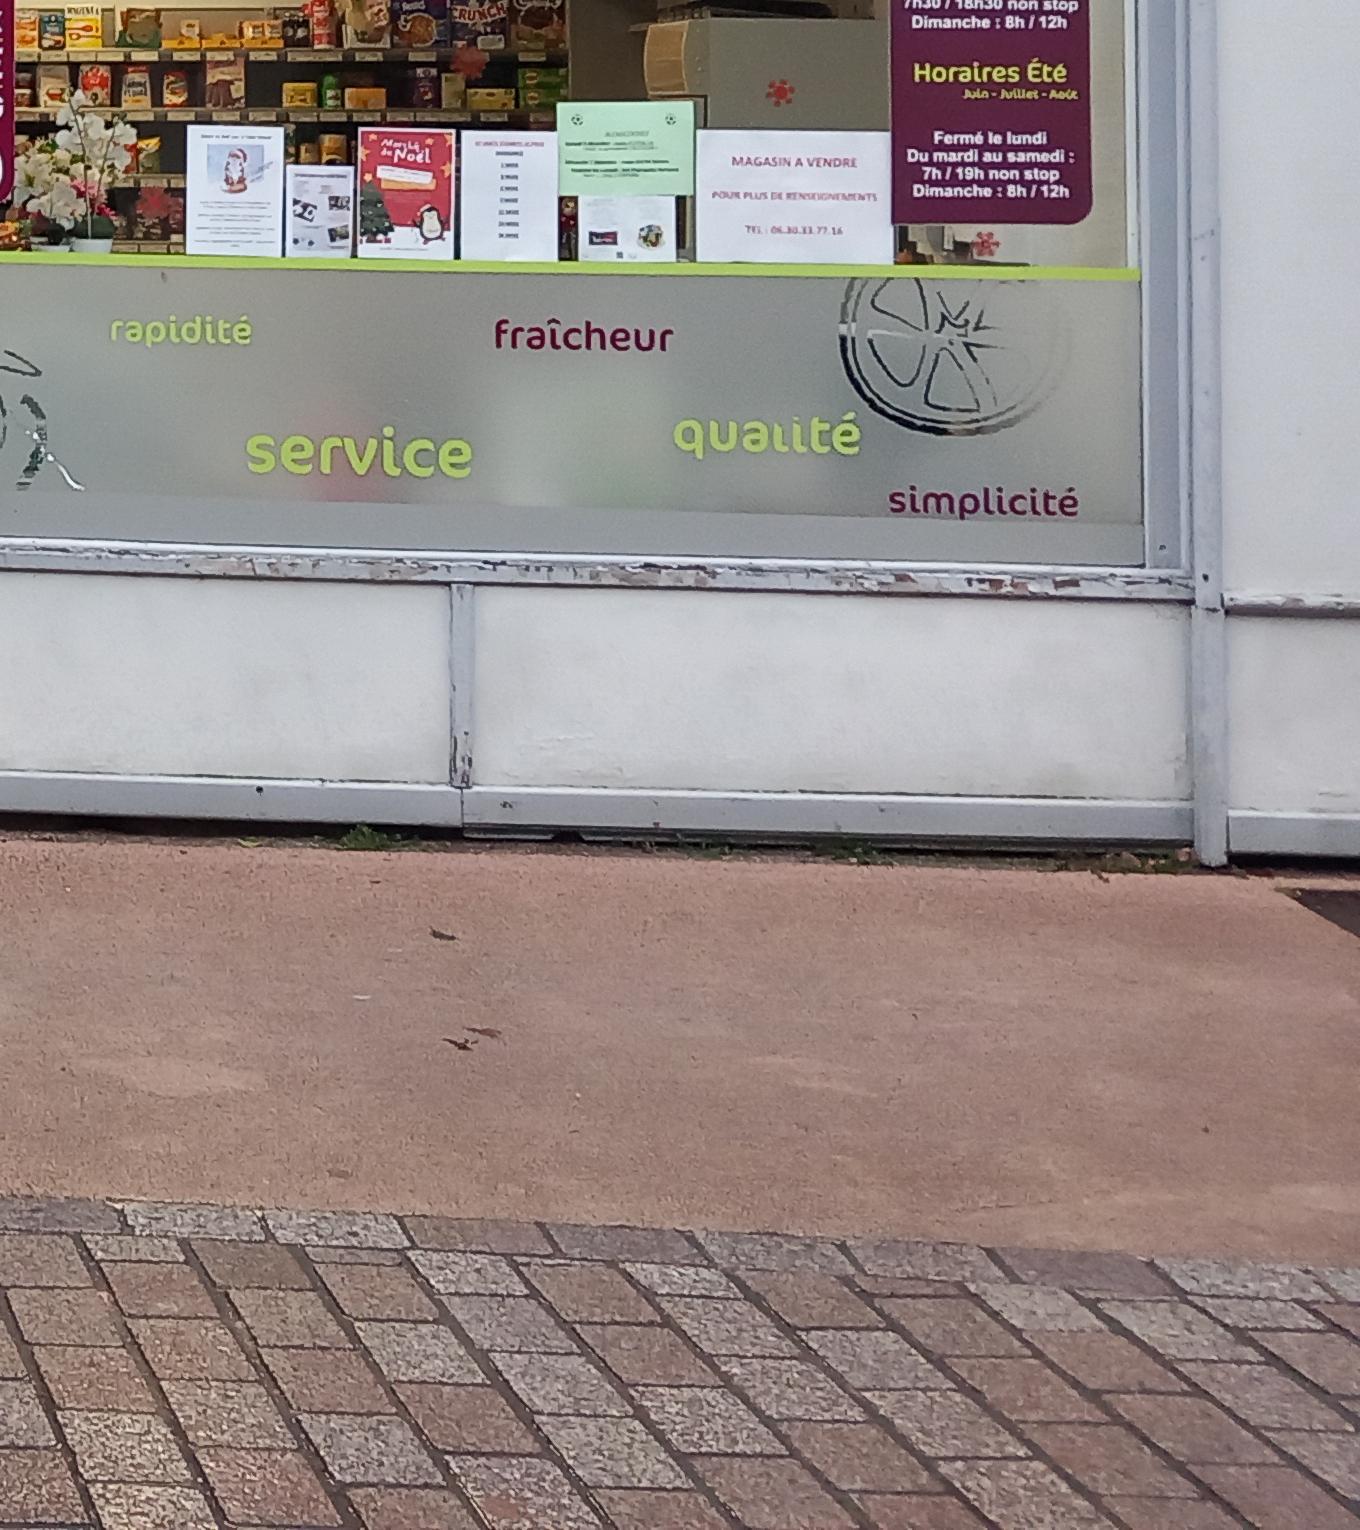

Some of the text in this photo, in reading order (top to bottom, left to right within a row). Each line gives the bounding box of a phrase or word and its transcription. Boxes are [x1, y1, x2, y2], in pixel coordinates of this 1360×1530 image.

[451, 1, 507, 21] CRUNCH
[1007, 0, 1038, 10] non
[912, 15, 991, 29] Dimanche
[1005, 15, 1025, 29] 8h
[1028, 16, 1035, 29] /
[1039, 16, 1068, 29] 12h
[913, 57, 1068, 83] Horaires Été
[962, 88, 989, 100] Juin
[999, 88, 1039, 100] Juillet
[933, 131, 1047, 145] Fermé le lundi
[394, 148, 431, 163] Noël
[732, 156, 857, 168] MAGASIN A VENDRE
[906, 149, 929, 163] Du
[933, 149, 979, 163] mardi
[982, 152, 1002, 163] au
[1007, 149, 1065, 163] samedi
[922, 166, 1060, 183] 7h / 19h non stop
[711, 191, 740, 200] POUR
[743, 191, 768, 200] PLUS
[912, 184, 992, 198] Dimanche
[1007, 184, 1026, 198] 8h
[1030, 185, 1037, 198] /
[1040, 184, 1070, 198] 12h
[109, 314, 253, 347] rapidité
[494, 318, 675, 352] fraîcheur
[673, 411, 861, 459] qualité
[246, 425, 472, 479] service
[888, 484, 1079, 520] simplicité
